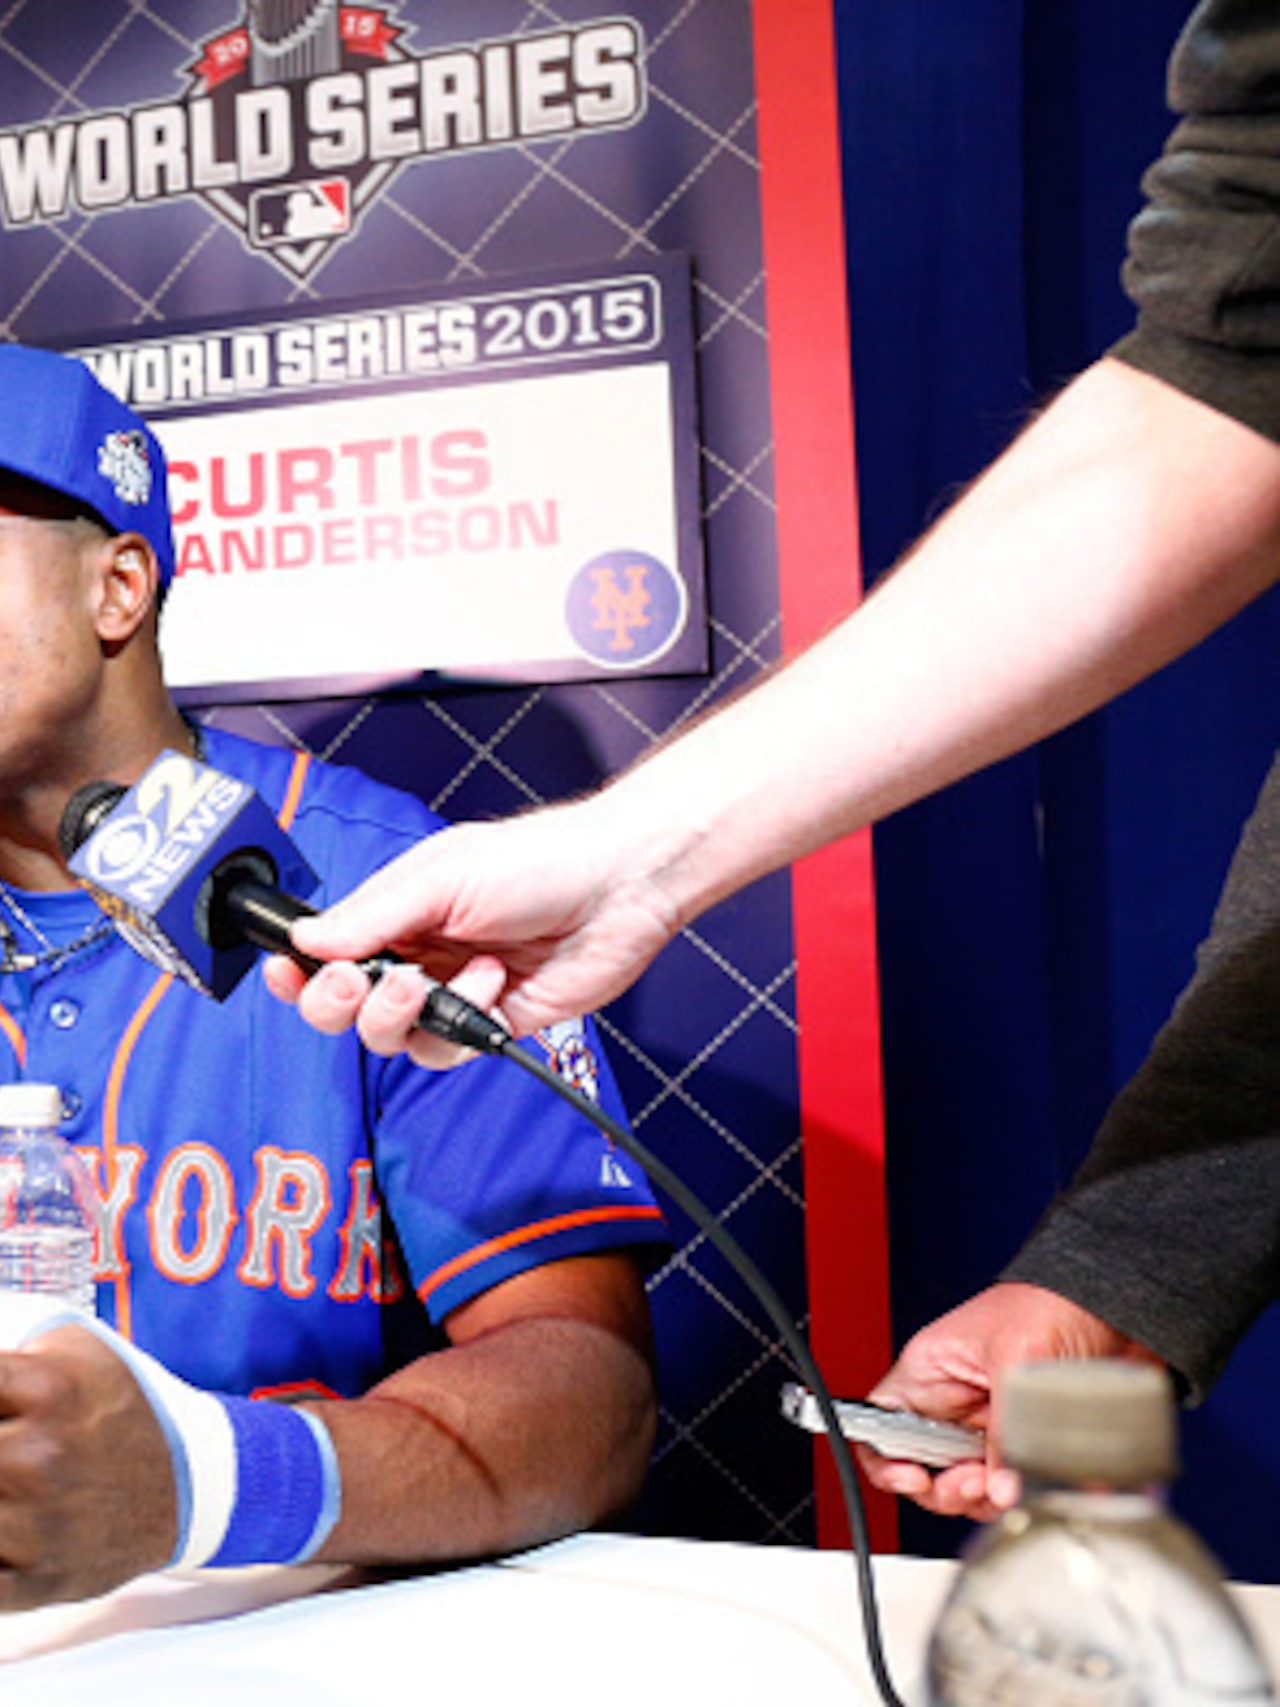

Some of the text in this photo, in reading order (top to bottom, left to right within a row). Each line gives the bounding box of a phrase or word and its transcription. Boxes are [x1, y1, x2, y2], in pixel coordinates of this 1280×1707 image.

[307, 24, 638, 168] SERIES
[84, 289, 646, 405] WORLD SERIES 2015
[167, 428, 493, 527] CURTIS
[174, 497, 561, 578] ANDERSON
[127, 778, 245, 902] NEWS
[136, 756, 221, 838] 2
